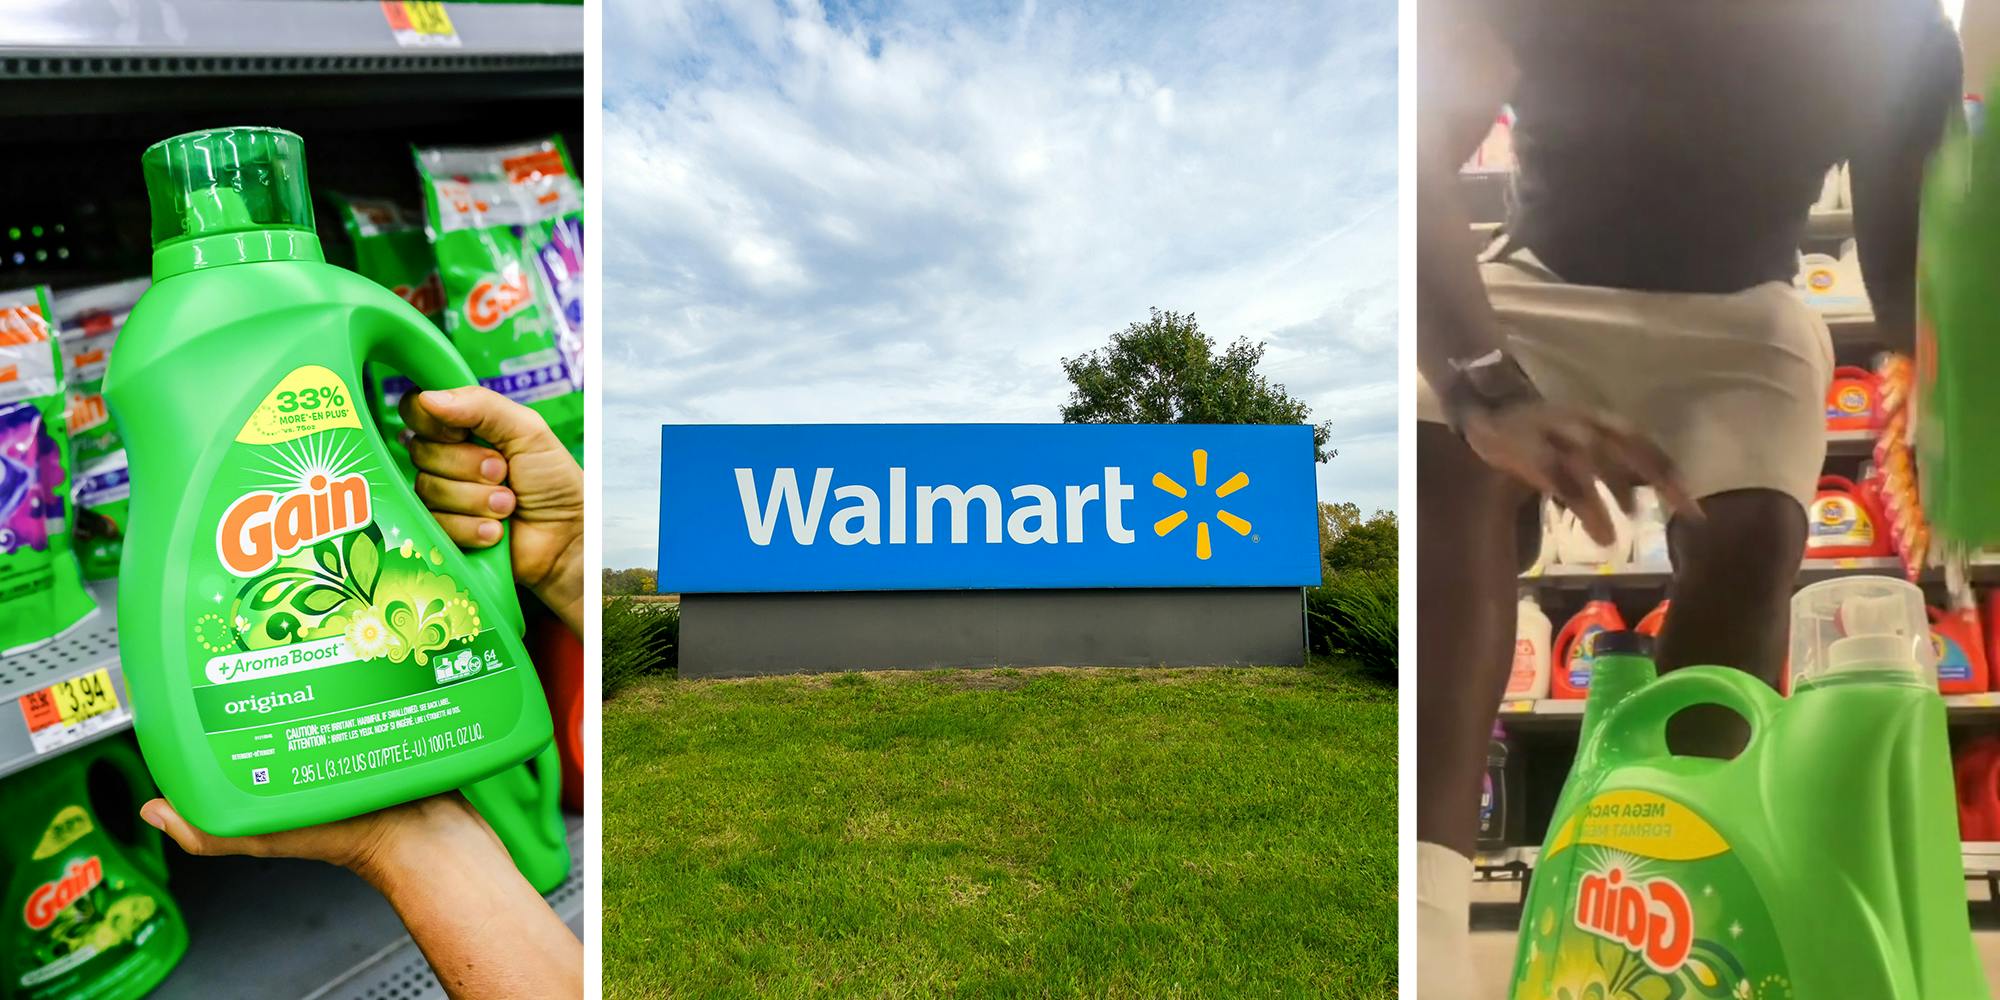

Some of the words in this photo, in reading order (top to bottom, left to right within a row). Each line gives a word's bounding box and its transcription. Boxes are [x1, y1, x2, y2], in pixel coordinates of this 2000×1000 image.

[276, 386, 344, 412] 33%
[734, 466, 1136, 546] Walmart
[220, 473, 371, 574] Gain
[483, 648, 496, 662] 64
[64, 674, 107, 712] 3.94
[224, 685, 315, 714] original
[285, 724, 319, 740] CAUTION:
[320, 724, 331, 734] EYE
[288, 734, 327, 752] ATTENTION
[292, 763, 316, 785] 2.95
[316, 763, 324, 780] L
[325, 757, 351, 780] (3.12
[352, 753, 367, 773] US
[367, 744, 402, 769] QT/PTE
[429, 734, 445, 753] 100
[445, 731, 456, 749] FL
[456, 727, 469, 746] OZ
[469, 722, 484, 744] LIQ.
[24, 855, 103, 929] Gain
